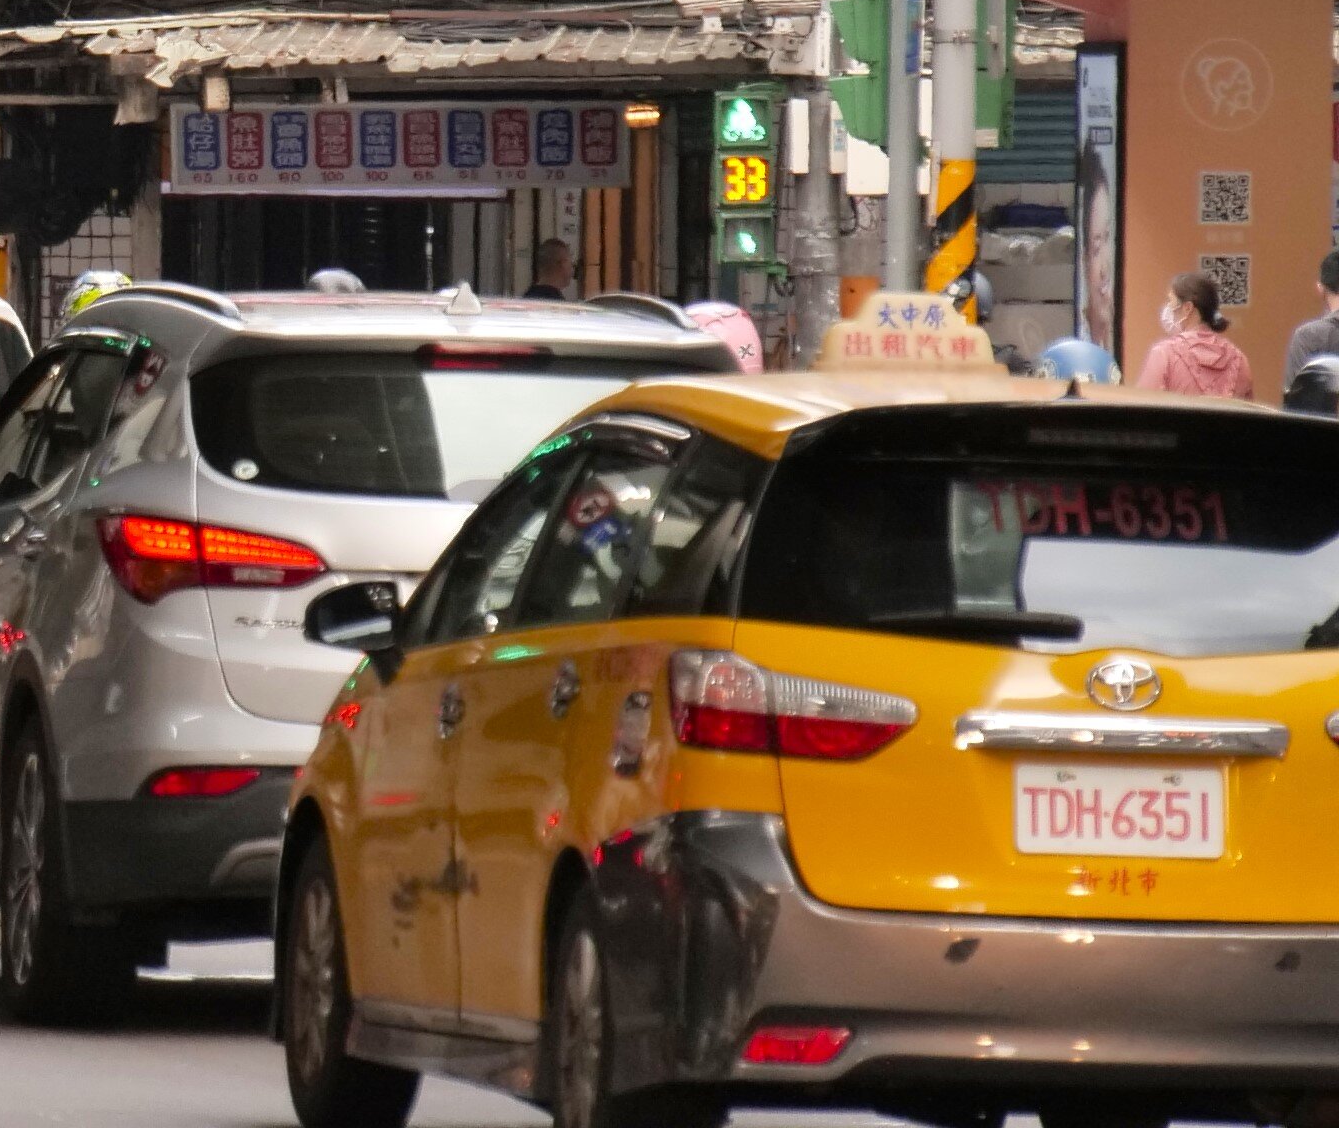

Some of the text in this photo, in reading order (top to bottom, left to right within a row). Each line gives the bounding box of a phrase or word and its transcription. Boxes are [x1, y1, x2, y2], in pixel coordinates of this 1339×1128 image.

[722, 156, 767, 201] 33
[978, 481, 1228, 542] TDH-6351
[1023, 786, 1209, 842] TDH-6351
